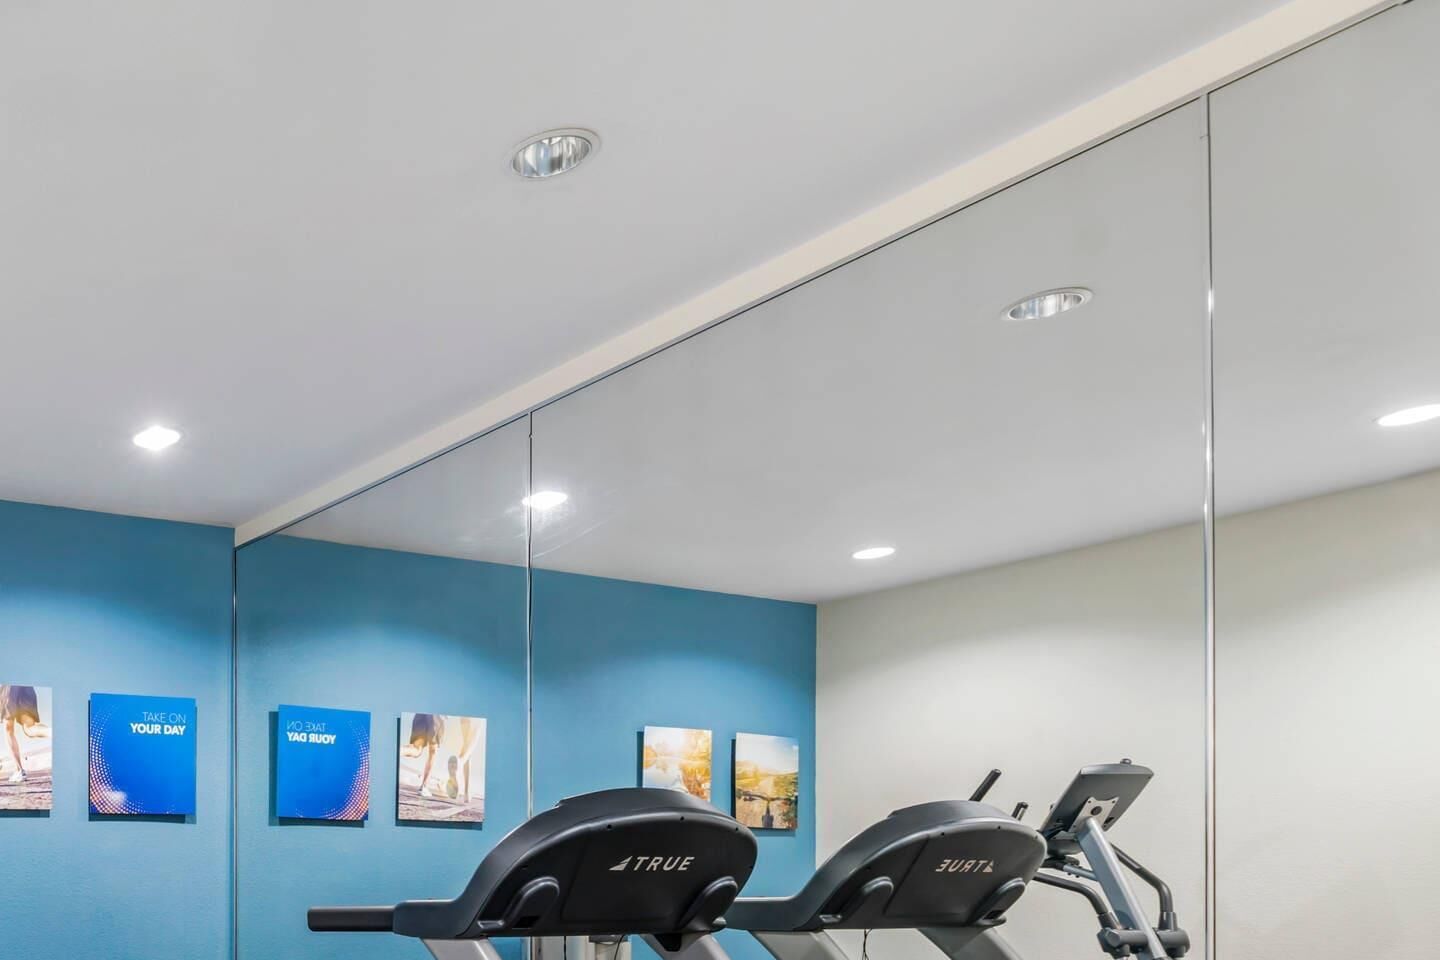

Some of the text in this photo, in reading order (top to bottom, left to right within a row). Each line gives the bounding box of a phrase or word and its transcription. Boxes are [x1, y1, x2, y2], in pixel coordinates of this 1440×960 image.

[142, 711, 187, 724] TAKE ON
[130, 722, 187, 736] YOUR DAY
[633, 855, 696, 871] TRUE
